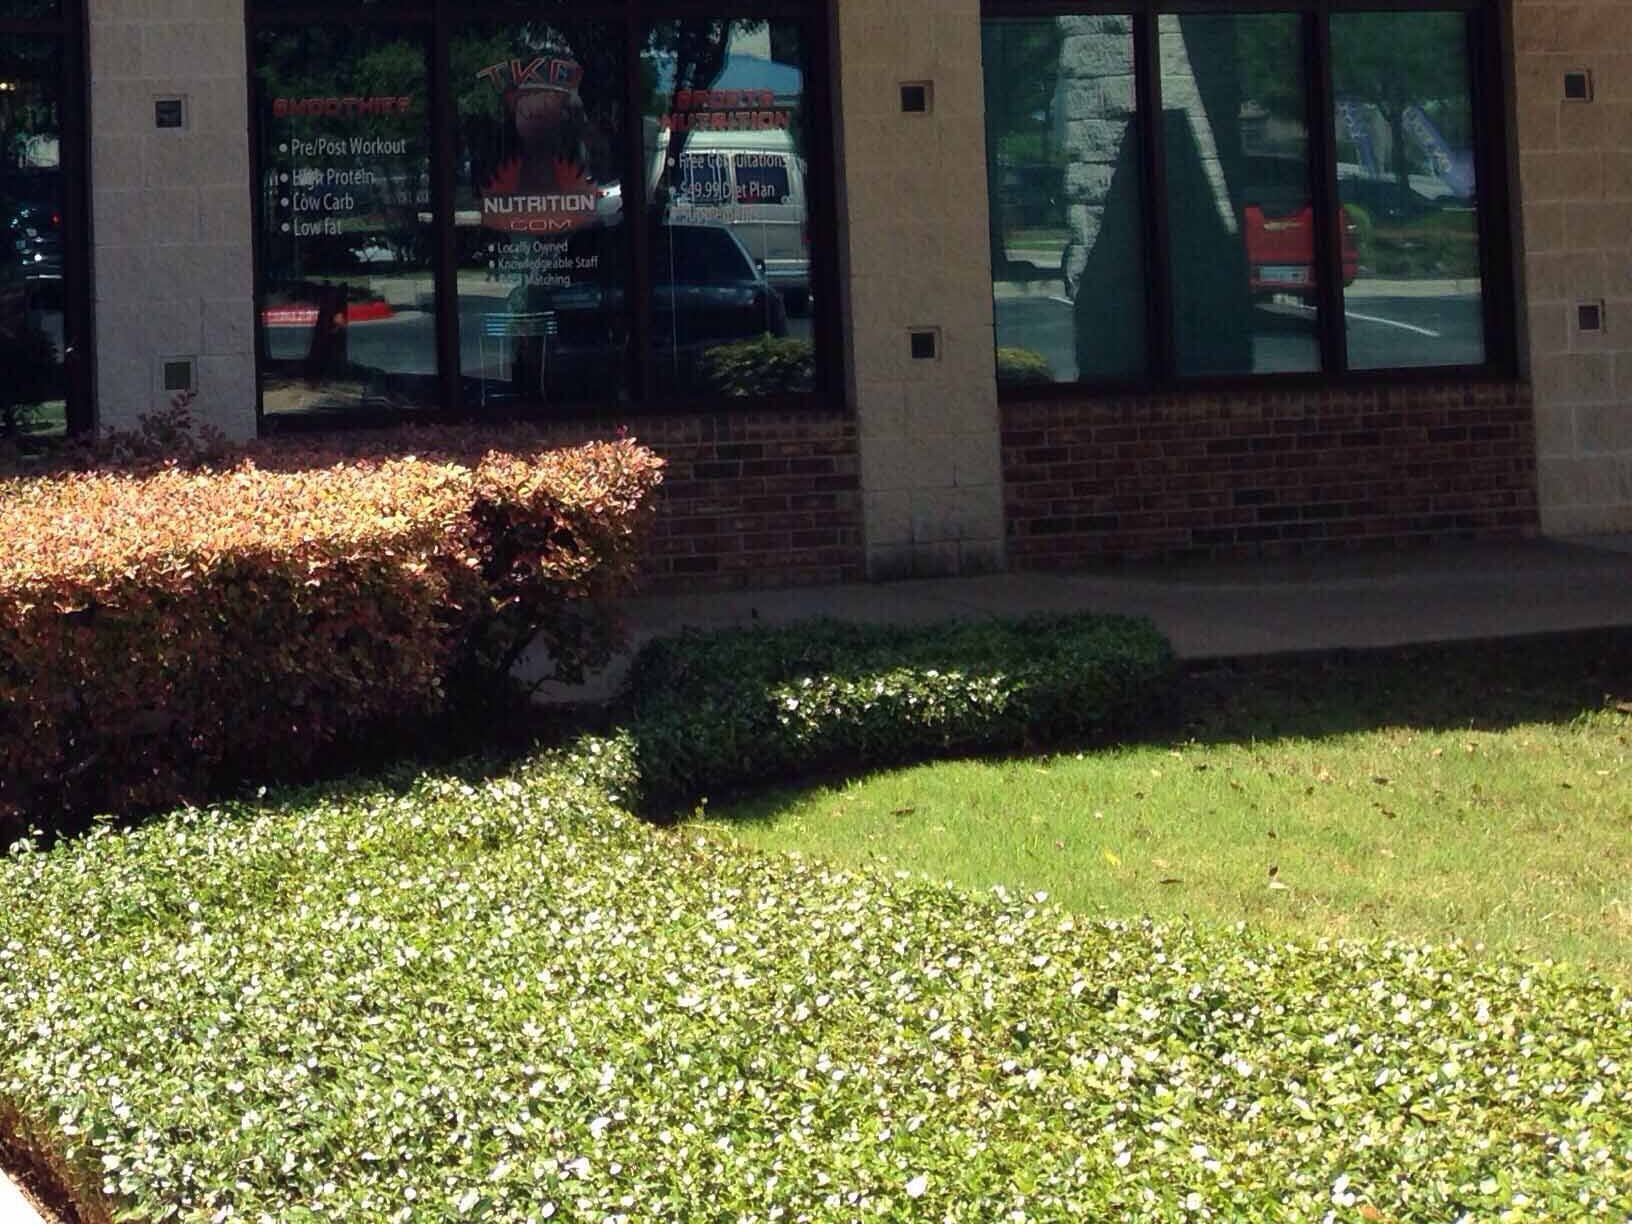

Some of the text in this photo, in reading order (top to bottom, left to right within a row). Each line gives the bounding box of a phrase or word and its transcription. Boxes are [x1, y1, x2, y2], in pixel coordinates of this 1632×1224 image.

[291, 136, 407, 157] Pre/Post Workout
[326, 167, 375, 185] Protein
[750, 181, 776, 198] Plan
[292, 191, 354, 211] Low Carb
[484, 194, 595, 214] NUTRITION
[293, 218, 321, 236] Low
[576, 255, 599, 270] Staff
